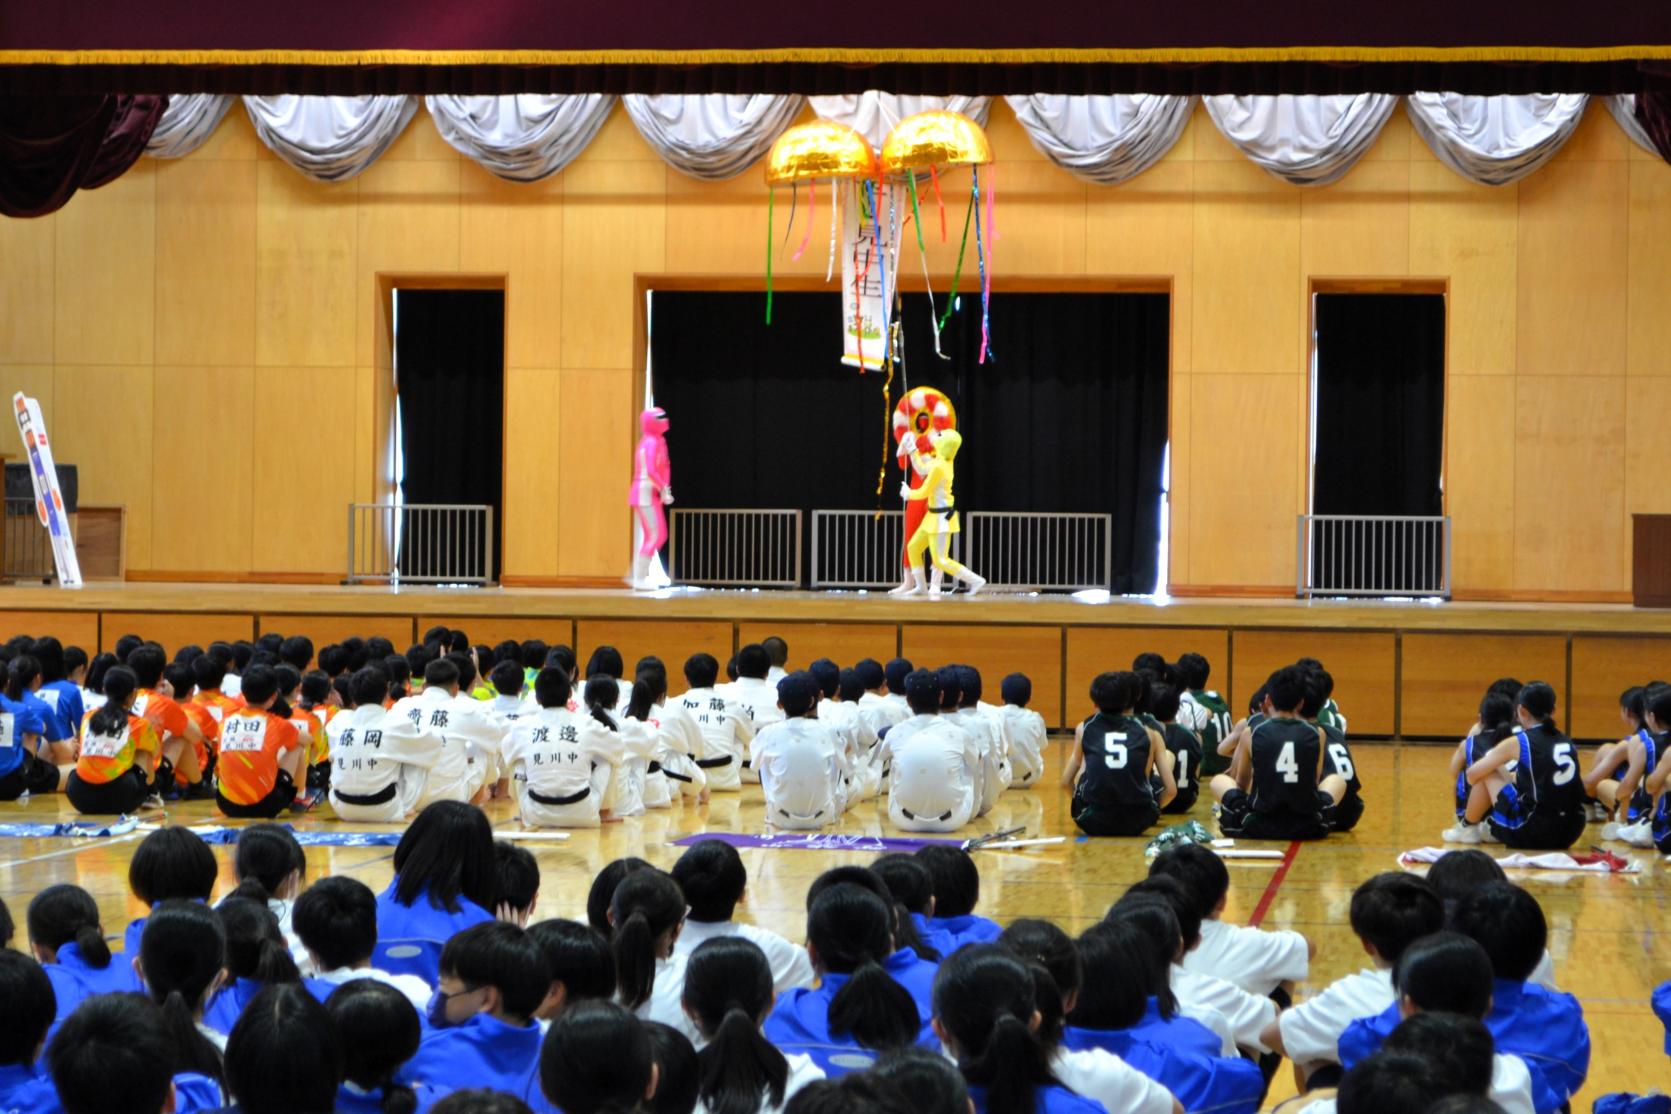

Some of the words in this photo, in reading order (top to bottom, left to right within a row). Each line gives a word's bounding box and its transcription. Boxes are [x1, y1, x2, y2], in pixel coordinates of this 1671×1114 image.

[226, 719, 260, 733] 村田
[699, 714, 725, 725] 川中
[339, 727, 383, 748] 藤岡
[1104, 732, 1128, 769] 5
[533, 752, 578, 765] 見川中
[1275, 741, 1299, 783] 4
[1328, 743, 1354, 781] 6
[1553, 743, 1576, 785] 5
